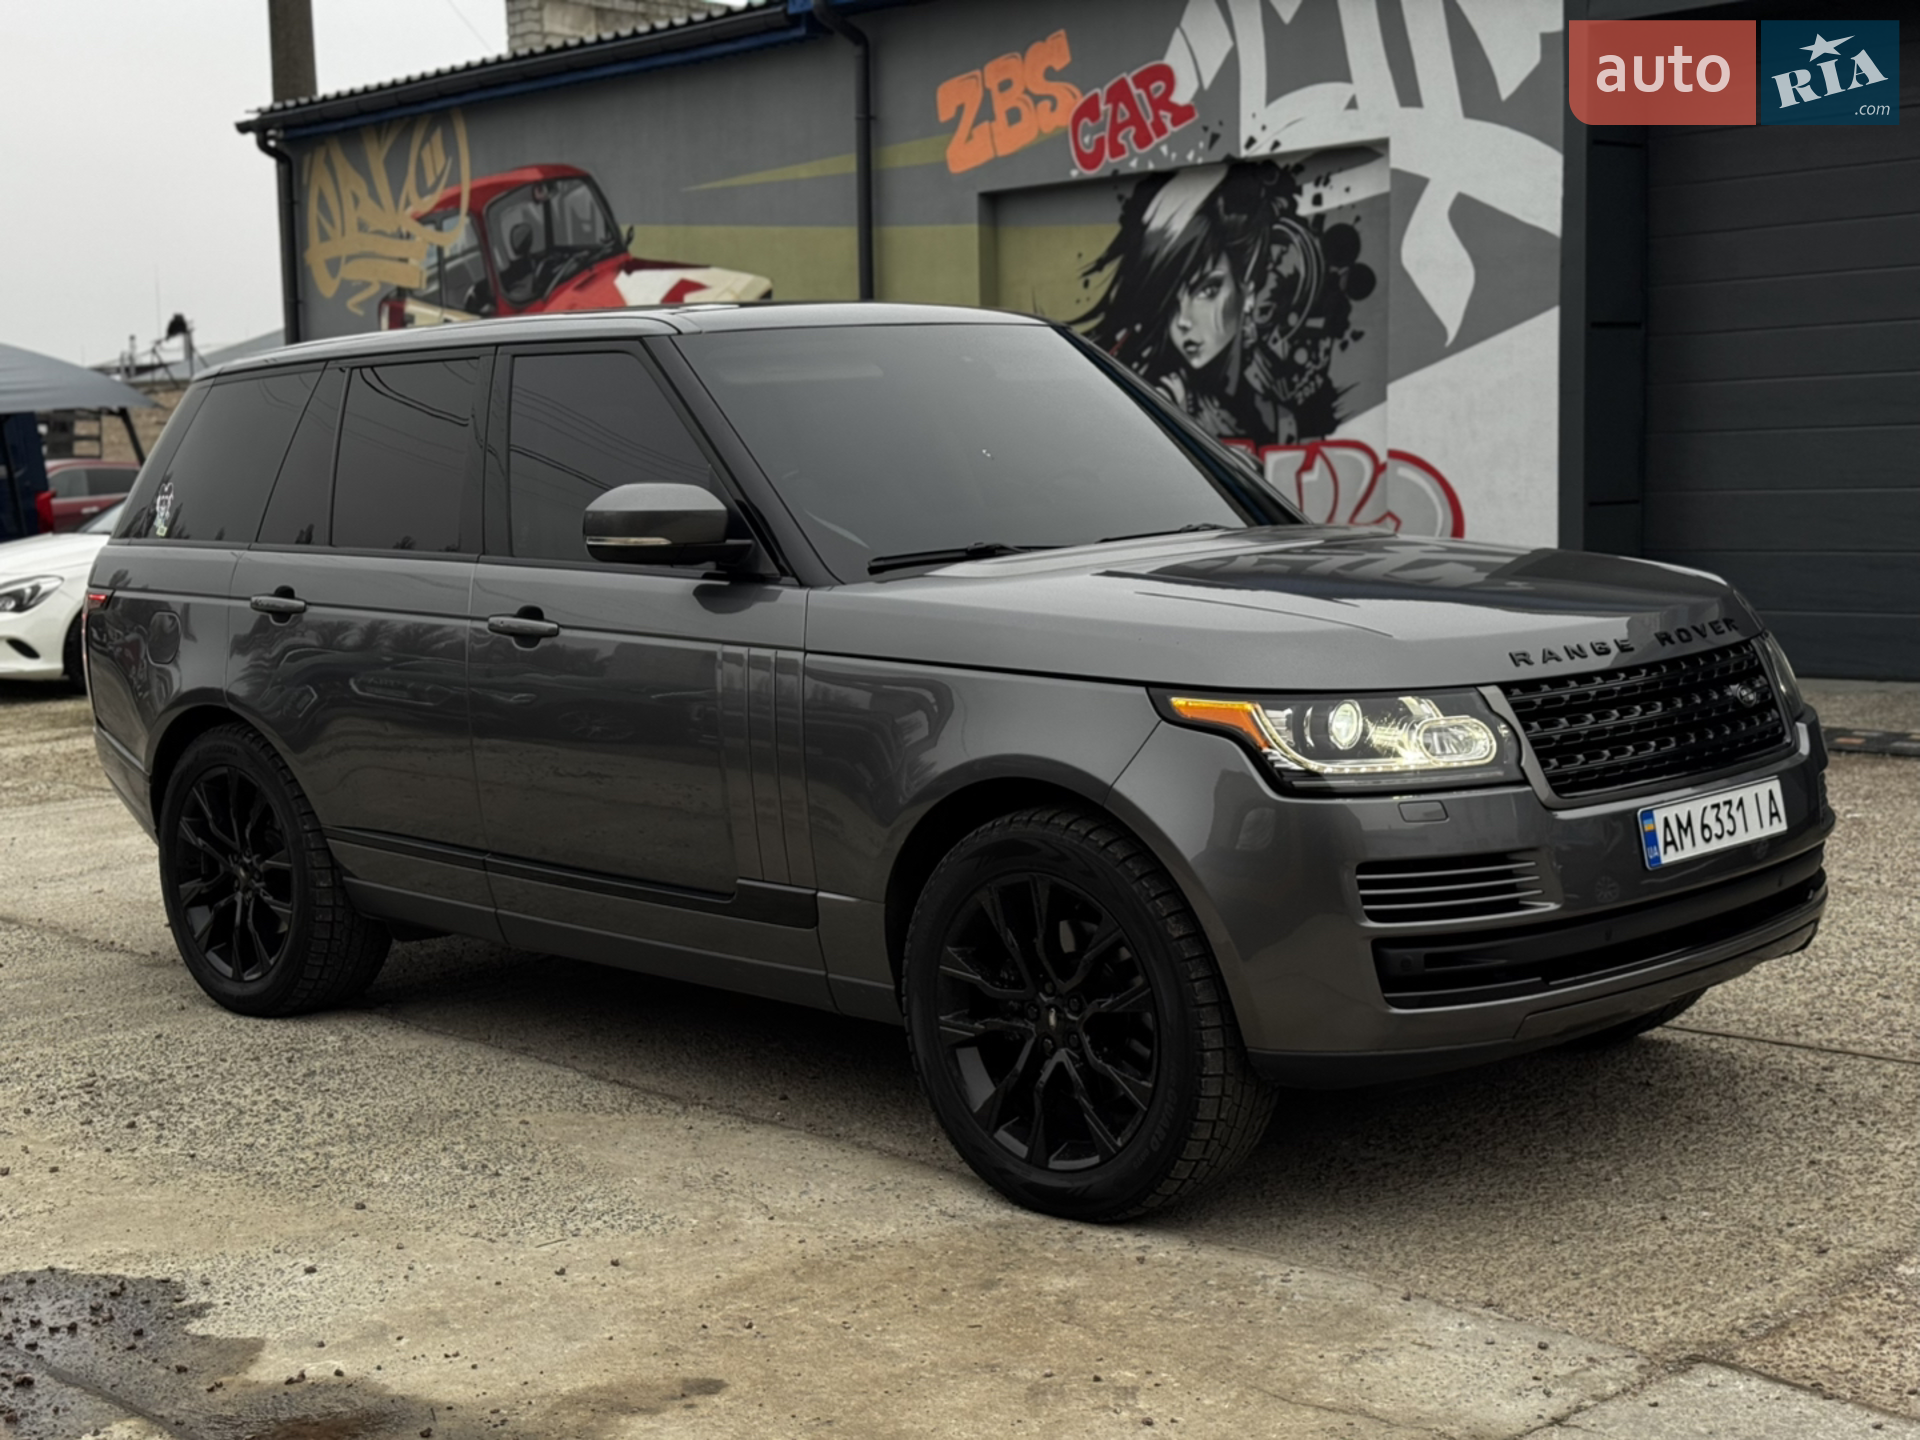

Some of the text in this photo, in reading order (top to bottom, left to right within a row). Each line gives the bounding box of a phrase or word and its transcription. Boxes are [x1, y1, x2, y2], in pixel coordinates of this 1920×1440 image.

[936, 28, 1198, 174] ZBS CAR
[1509, 616, 1740, 668] RANGE ROVER
[1663, 788, 1783, 856] AM 6331 IA
